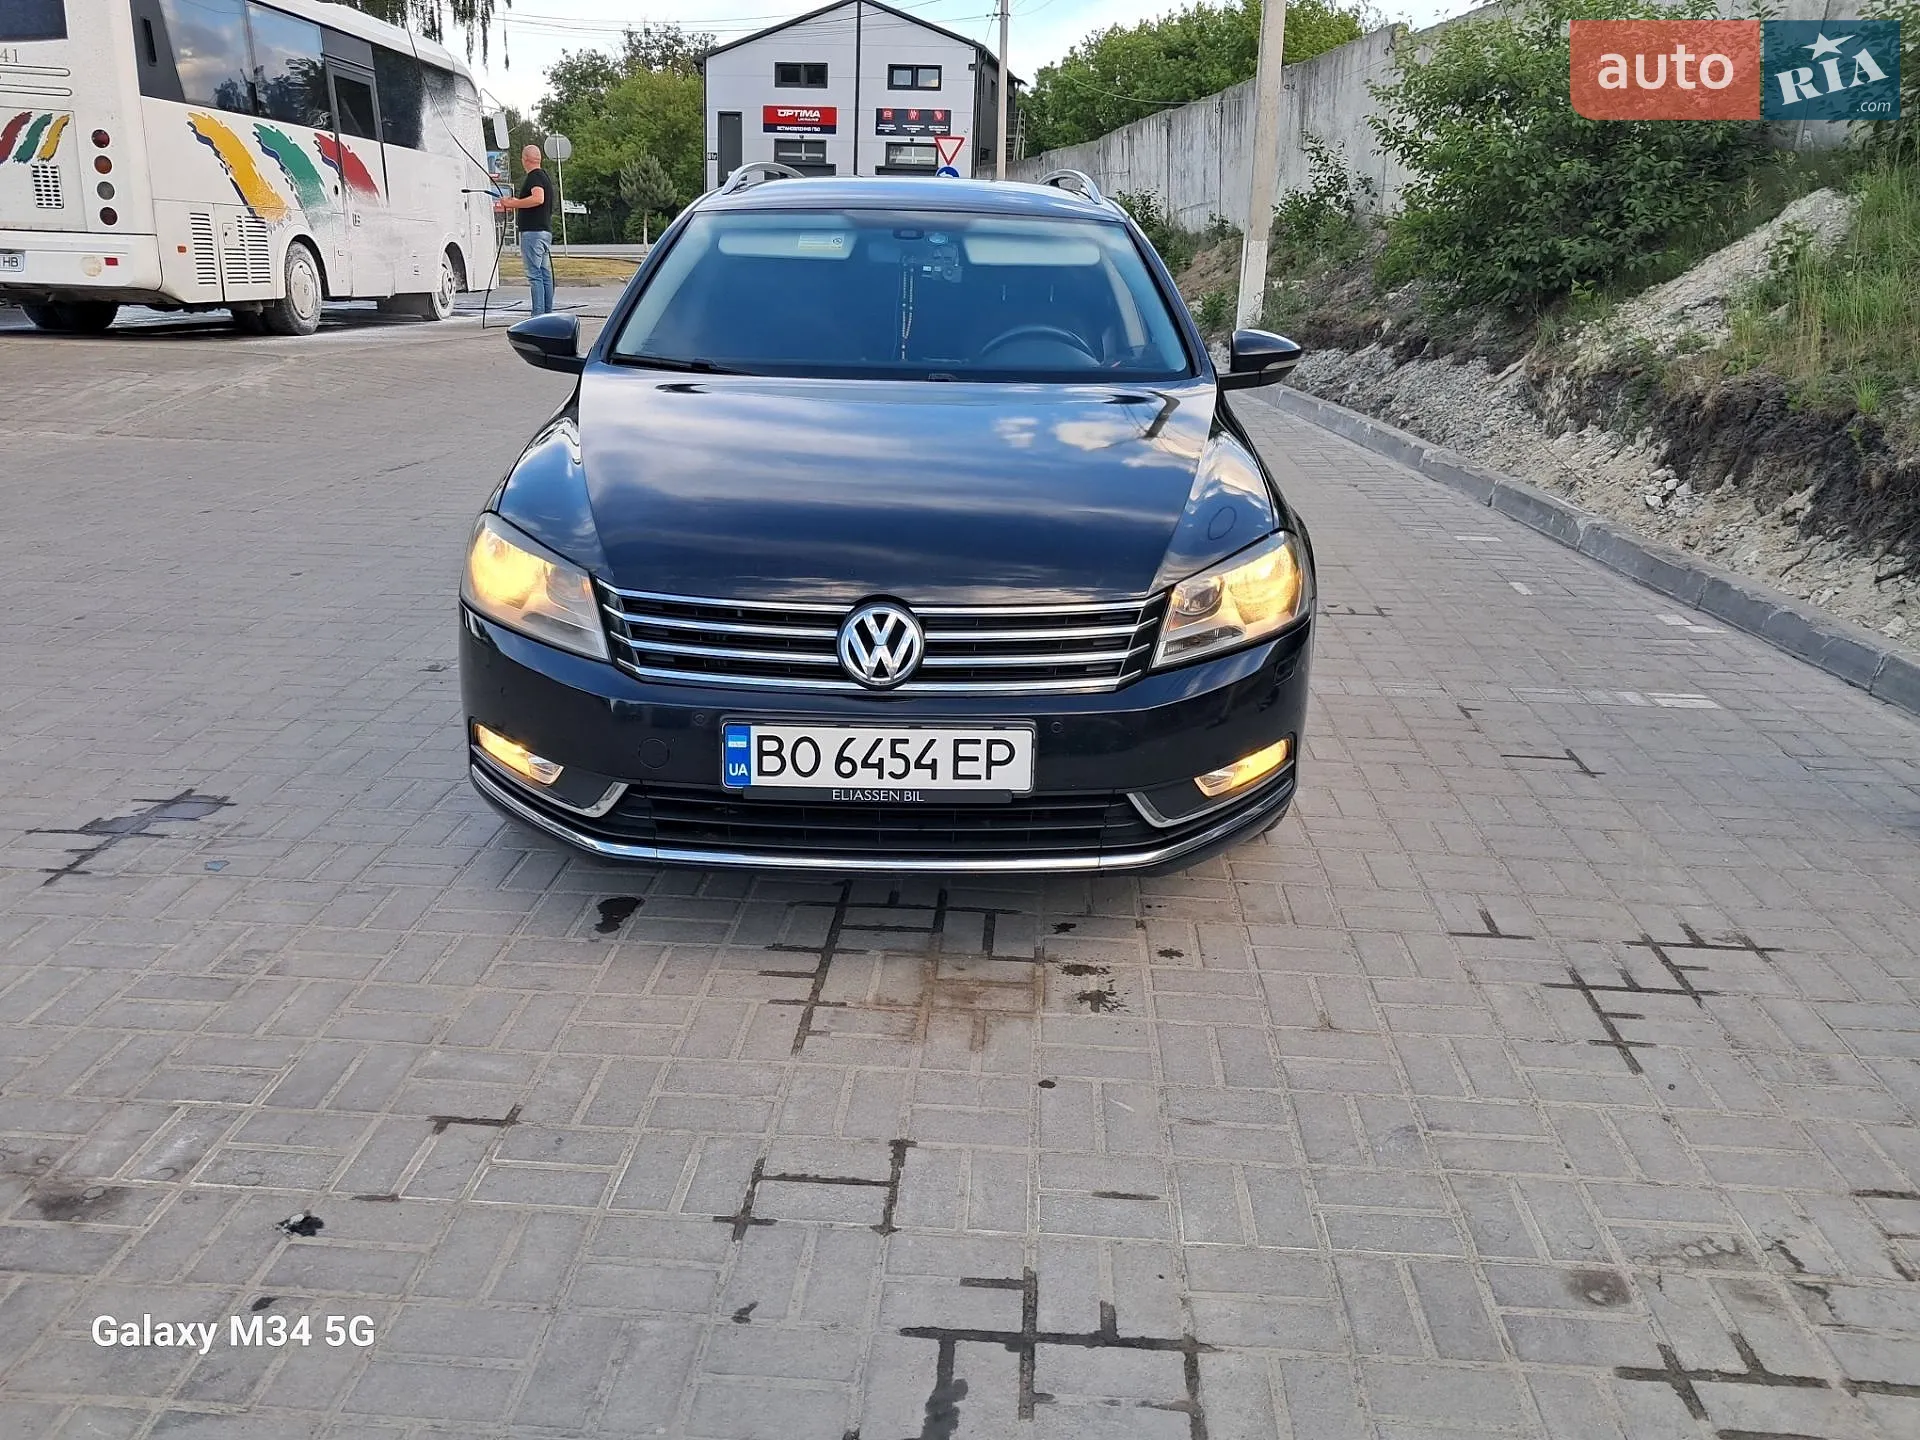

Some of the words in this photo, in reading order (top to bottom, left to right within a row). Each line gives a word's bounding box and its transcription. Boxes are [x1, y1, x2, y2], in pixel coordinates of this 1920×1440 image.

[777, 109, 821, 118] OPTIMA
[756, 734, 822, 778] BO
[834, 737, 938, 780] 6454
[952, 738, 1016, 781] EP
[729, 763, 748, 777] UA
[832, 789, 900, 802] ELIASSEN
[903, 789, 925, 803] BIL
